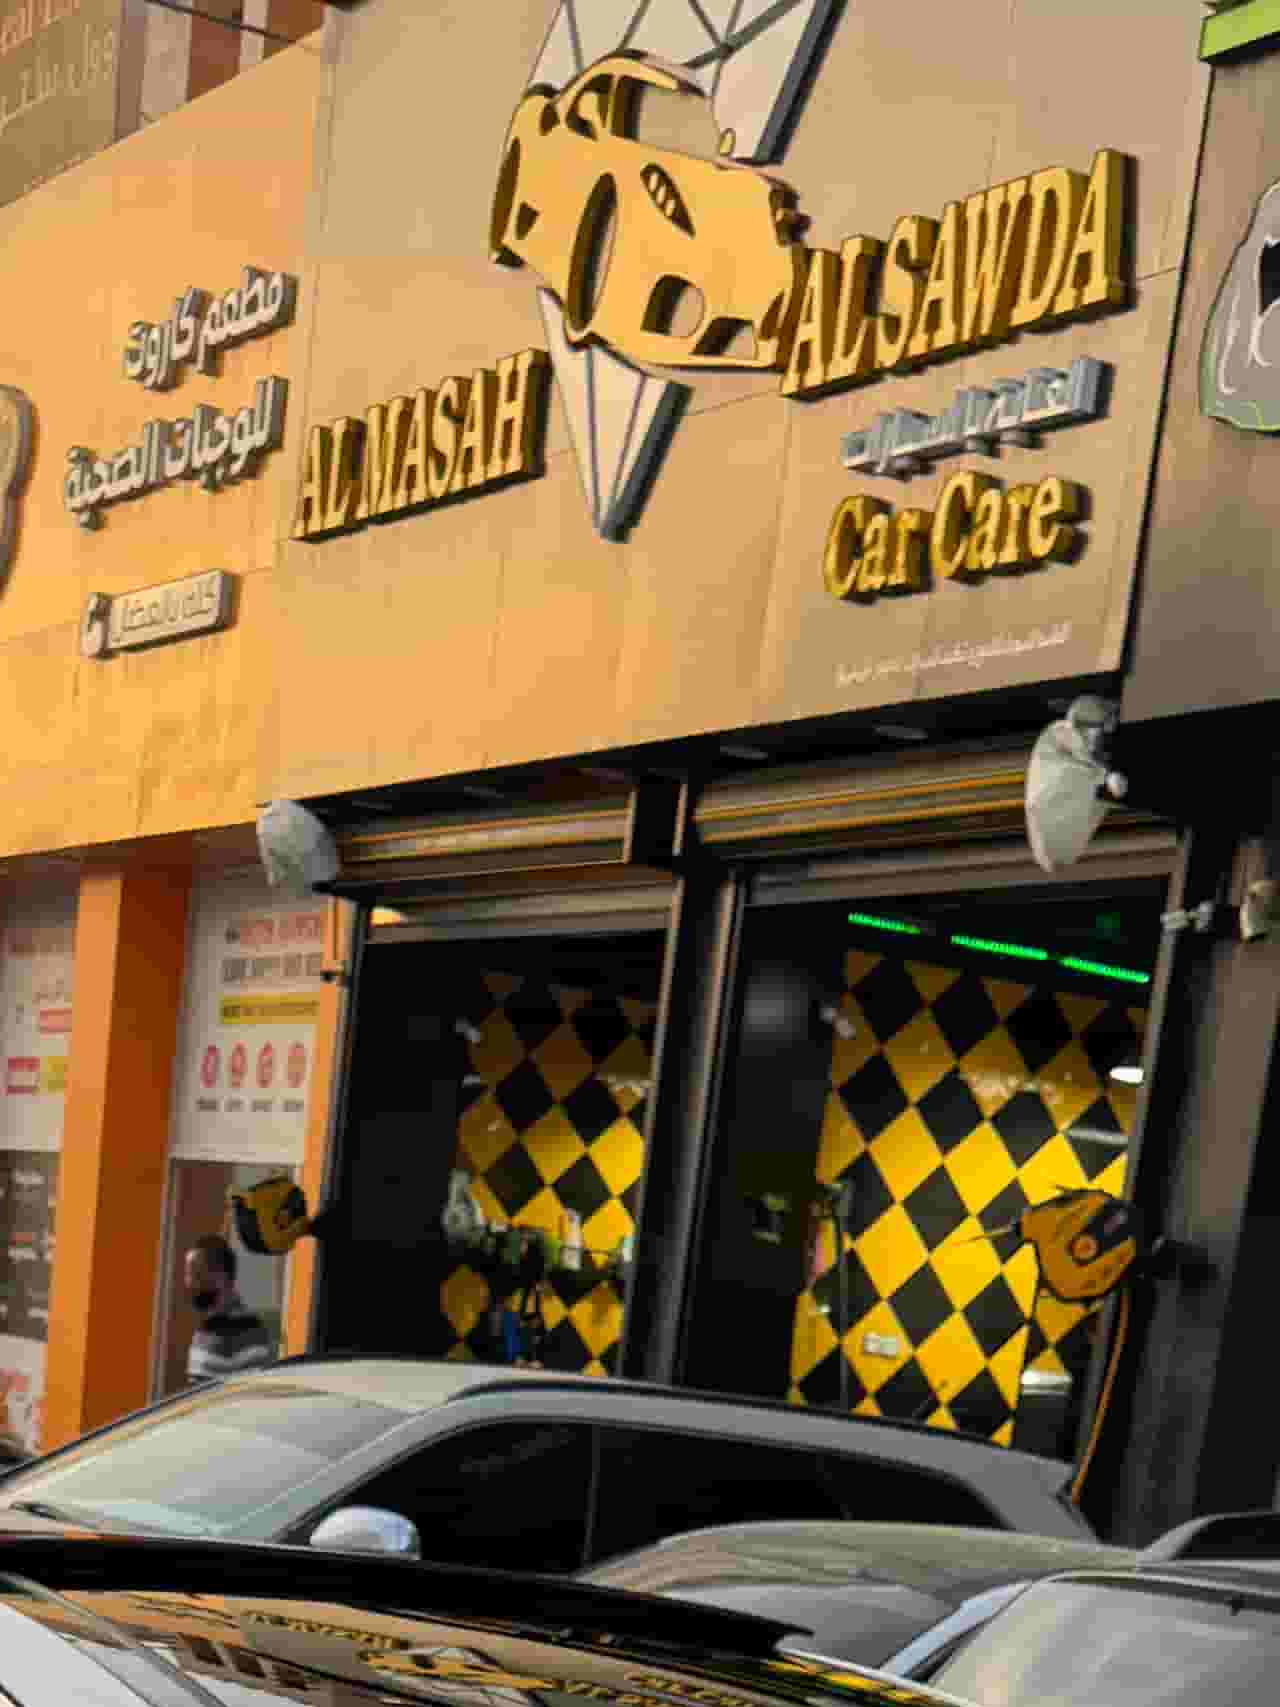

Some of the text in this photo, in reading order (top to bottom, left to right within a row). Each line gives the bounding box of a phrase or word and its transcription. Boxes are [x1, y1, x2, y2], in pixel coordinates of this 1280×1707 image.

[782, 150, 1122, 395] AL SAWDA
[294, 350, 542, 538] AL MASAH
[823, 470, 1064, 600] Car Care
